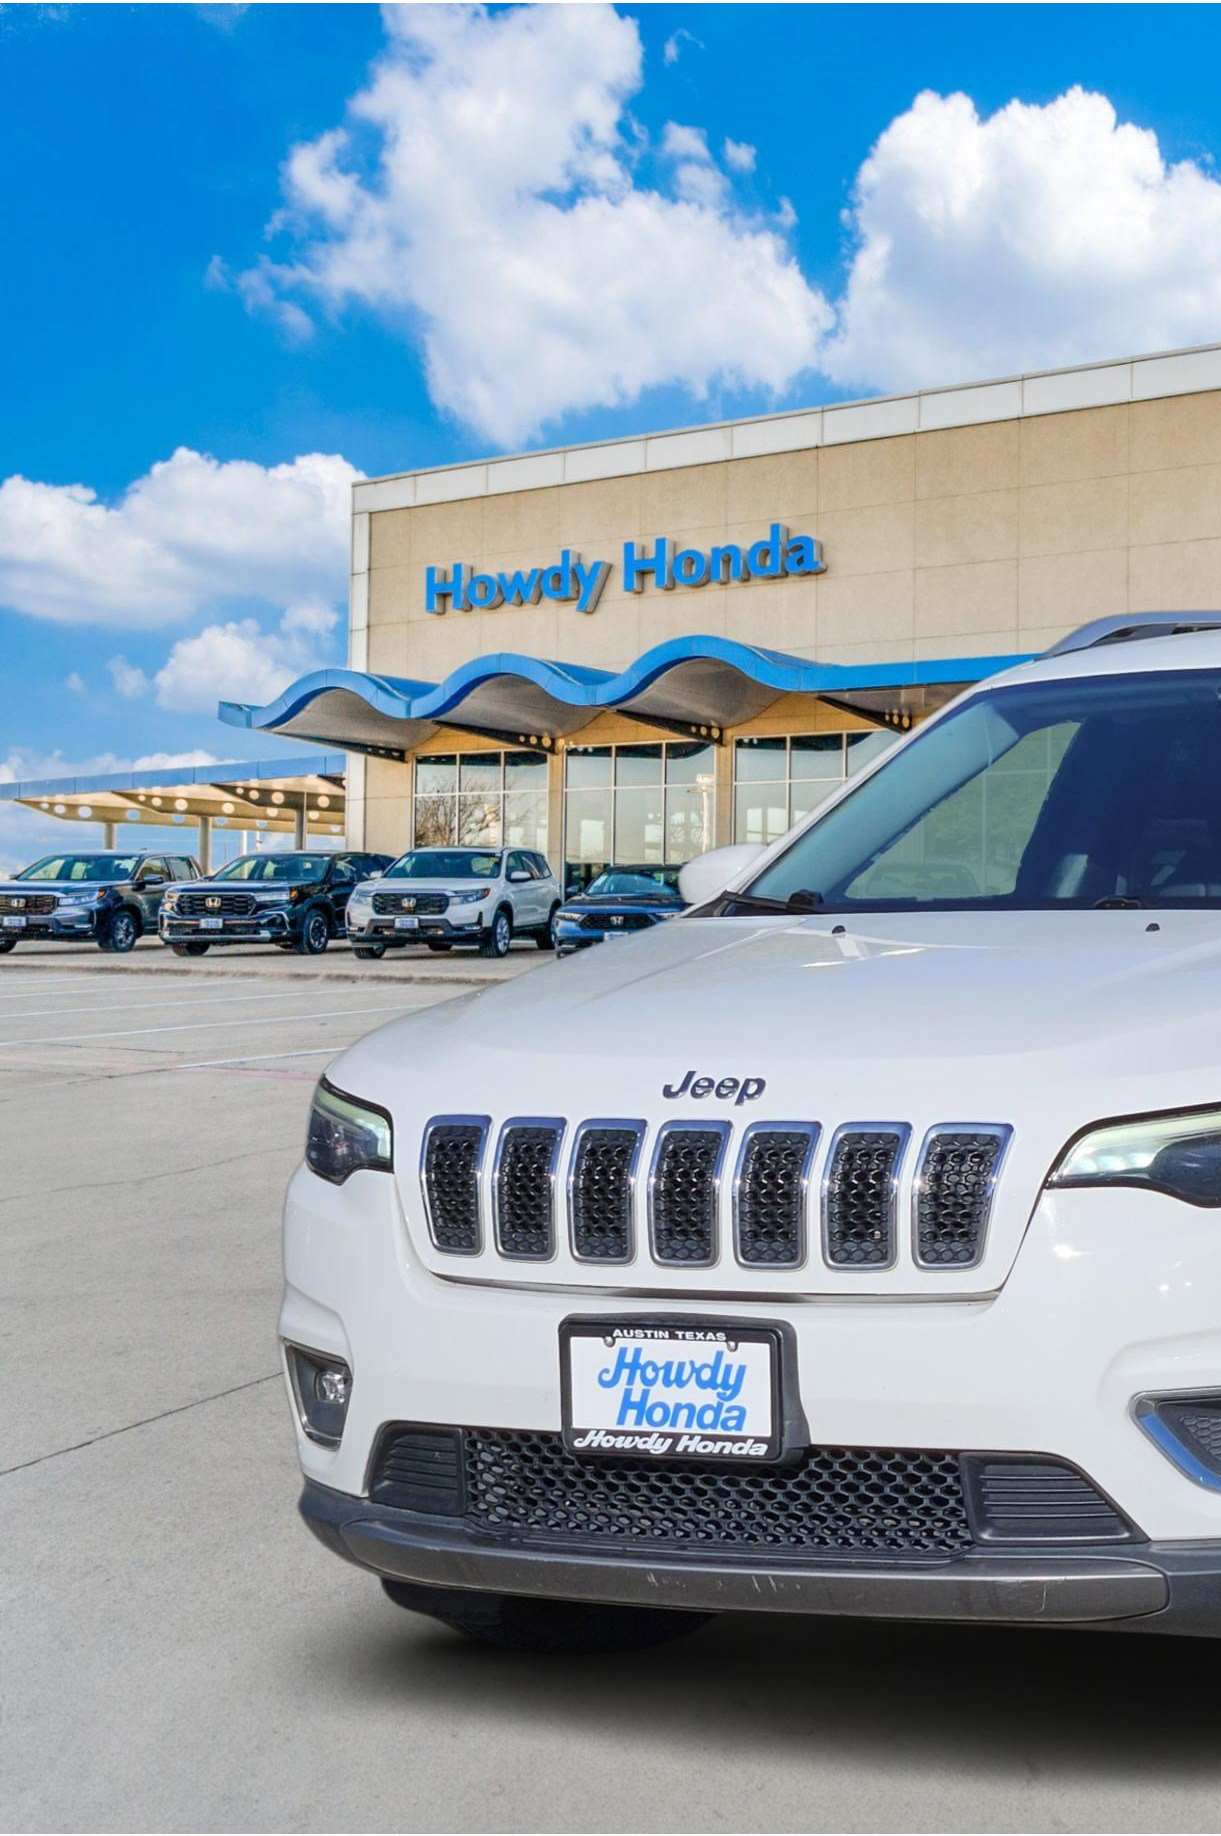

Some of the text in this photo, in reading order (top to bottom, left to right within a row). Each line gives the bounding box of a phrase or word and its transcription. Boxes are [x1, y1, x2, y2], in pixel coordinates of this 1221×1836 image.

[425, 523, 827, 615] Howdy Honda
[662, 1070, 766, 1106] Jeep
[612, 1329, 727, 1342] AUSTIN TEXAS
[597, 1347, 747, 1401] Howdy
[616, 1388, 747, 1432] Honda
[573, 1430, 769, 1456] Howdy Honda
